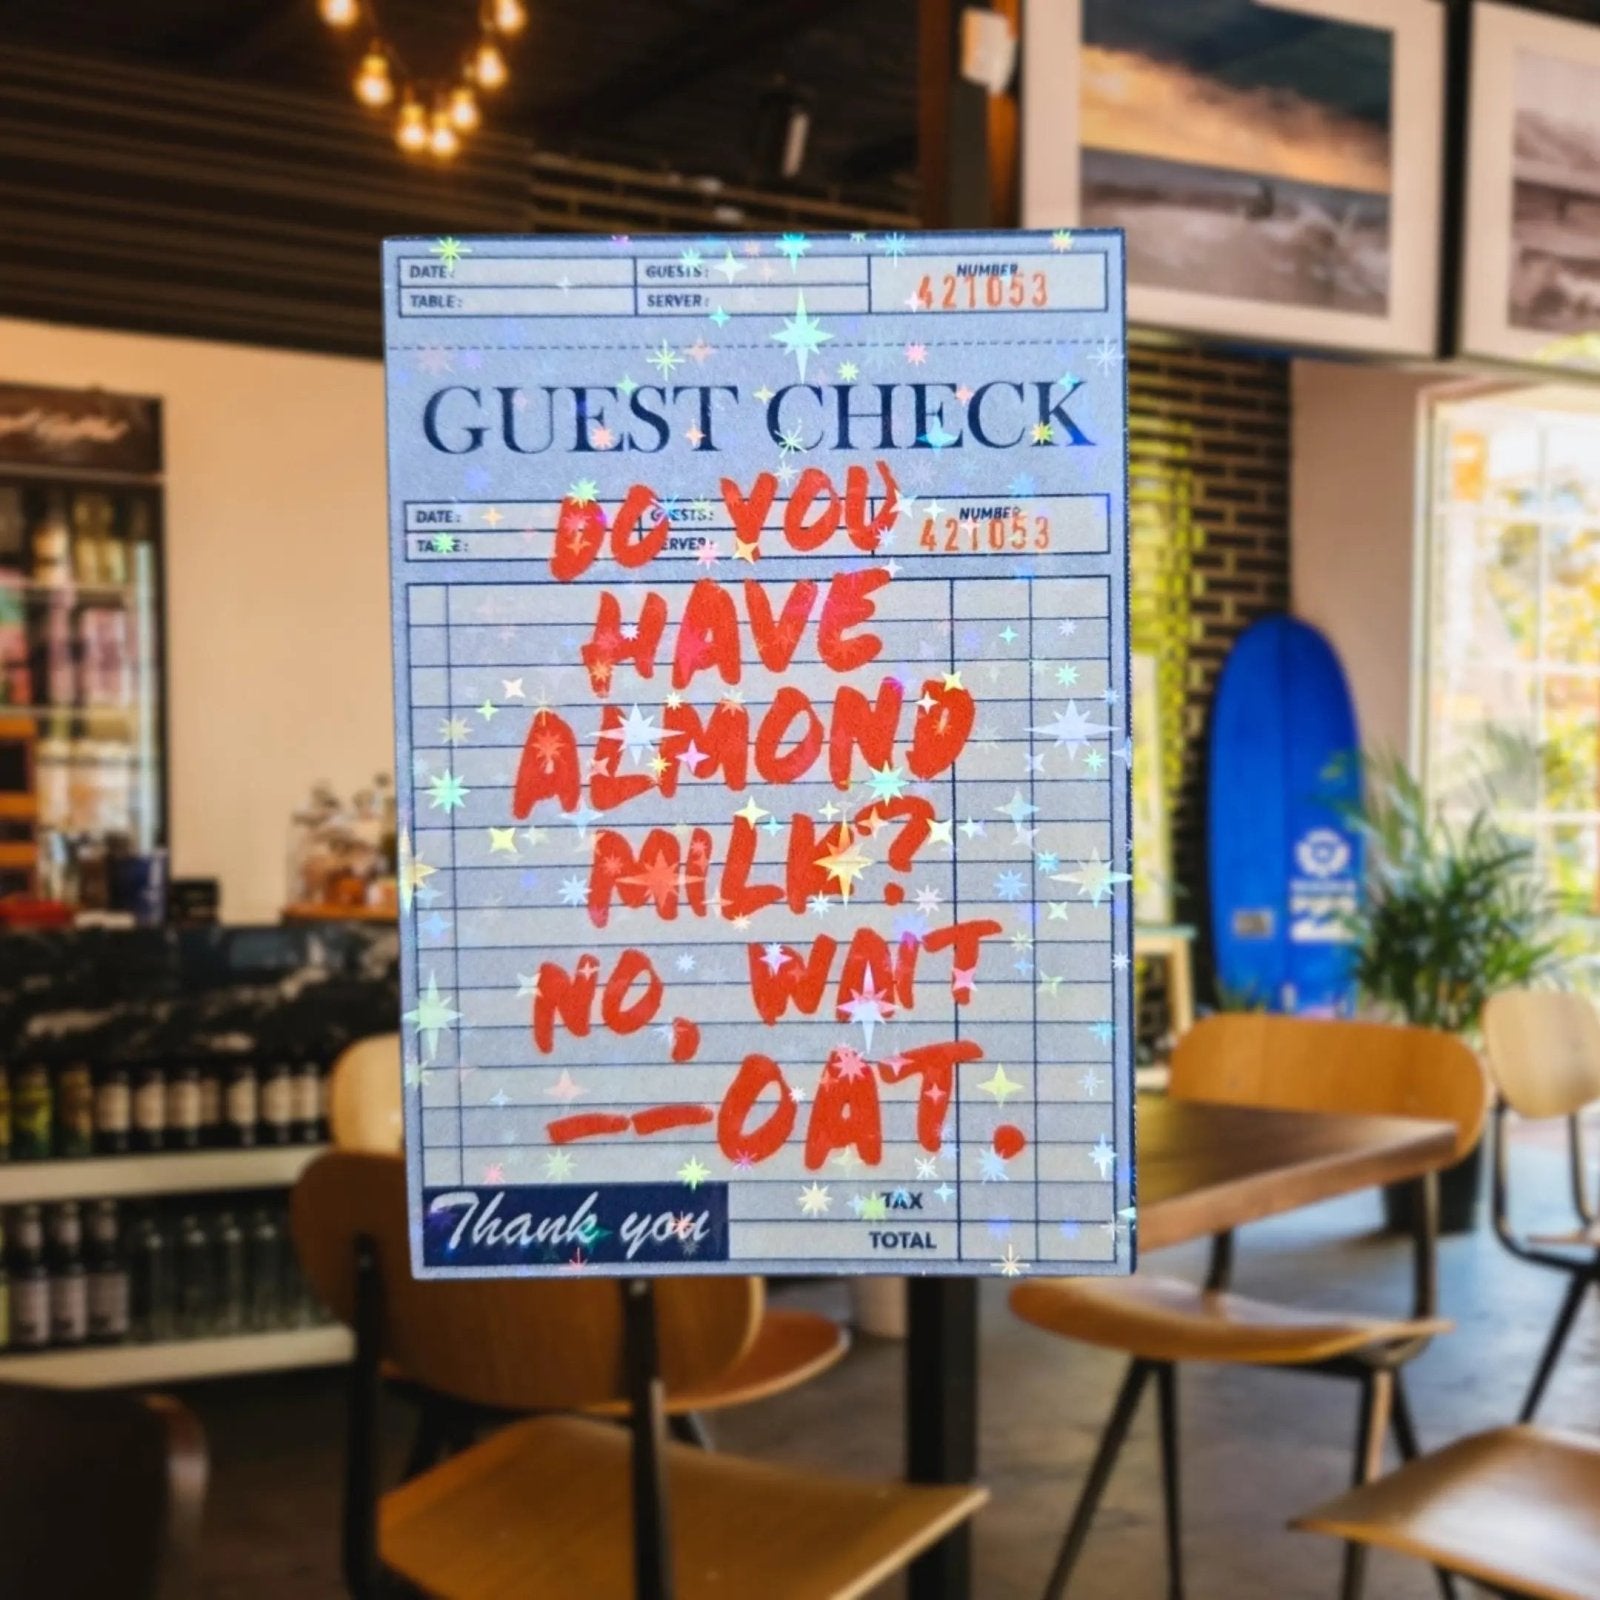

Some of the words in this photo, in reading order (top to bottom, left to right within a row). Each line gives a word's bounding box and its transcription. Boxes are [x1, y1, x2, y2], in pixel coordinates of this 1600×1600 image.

[956, 264, 1018, 278] NUMBER
[409, 294, 463, 309] TABLE:
[646, 294, 711, 308] SERVER:
[918, 272, 1048, 310] 421053
[422, 385, 740, 455] GUEST
[765, 380, 1097, 452] CHECK
[416, 509, 462, 524] DATE:
[549, 484, 671, 584] DO
[720, 460, 900, 562] YOU
[959, 505, 1021, 521] NUMBER
[416, 538, 470, 554] TAE:
[919, 516, 1050, 552] 421053
[580, 566, 894, 698] HAVE
[512, 675, 977, 820] ALMOND
[587, 795, 936, 929] MILK?
[533, 947, 701, 1063] NO,
[747, 919, 1003, 1026] WAIT
[880, 1191, 924, 1210] TAX
[429, 1190, 600, 1251] Thank
[619, 1209, 710, 1261] you
[868, 1230, 938, 1250] TOTAL
